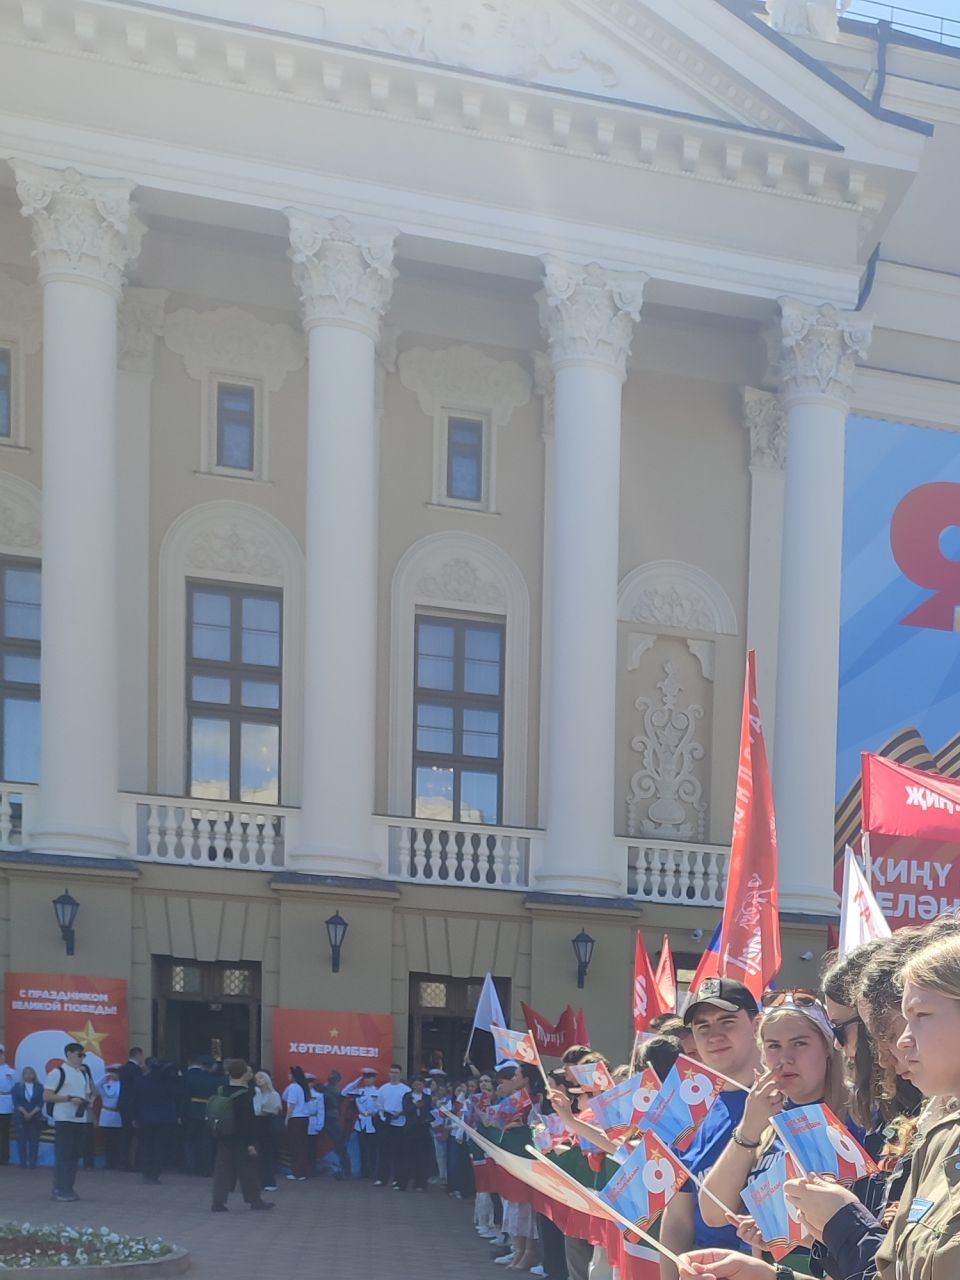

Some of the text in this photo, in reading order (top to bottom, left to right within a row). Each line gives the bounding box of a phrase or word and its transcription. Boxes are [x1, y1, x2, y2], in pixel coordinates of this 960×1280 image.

[19, 990, 109, 1003] С ПРАЗДНИКОМ
[11, 1000, 118, 1015] ВЕЛИКОЙ ПОБЕДЫ!
[289, 1042, 379, 1058] ХӘТЕРЛИБЕЗ!
